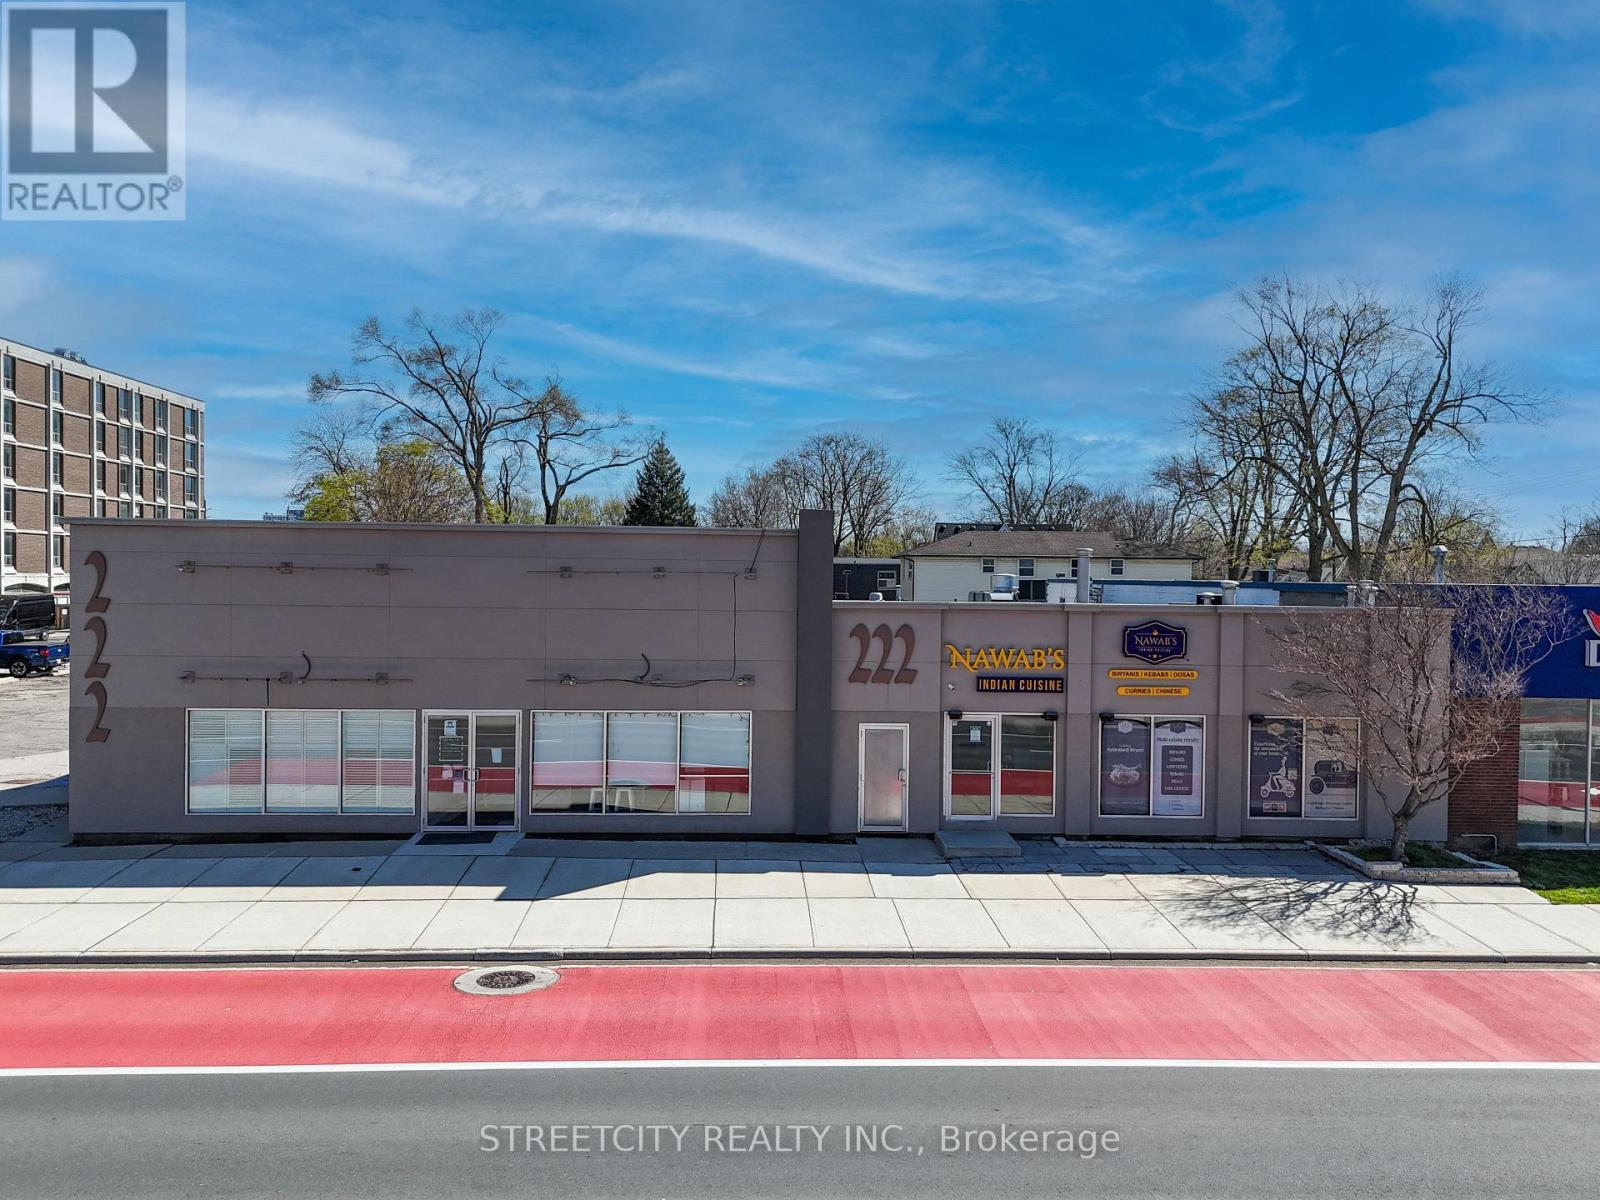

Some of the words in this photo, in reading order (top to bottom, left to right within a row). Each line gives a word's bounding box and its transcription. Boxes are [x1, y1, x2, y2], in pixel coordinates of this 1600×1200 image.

[848, 622, 918, 684] 222
[944, 643, 1066, 673] NAWAB'S
[979, 679, 1016, 691] INDIAN
[1019, 679, 1063, 691] CUISINE
